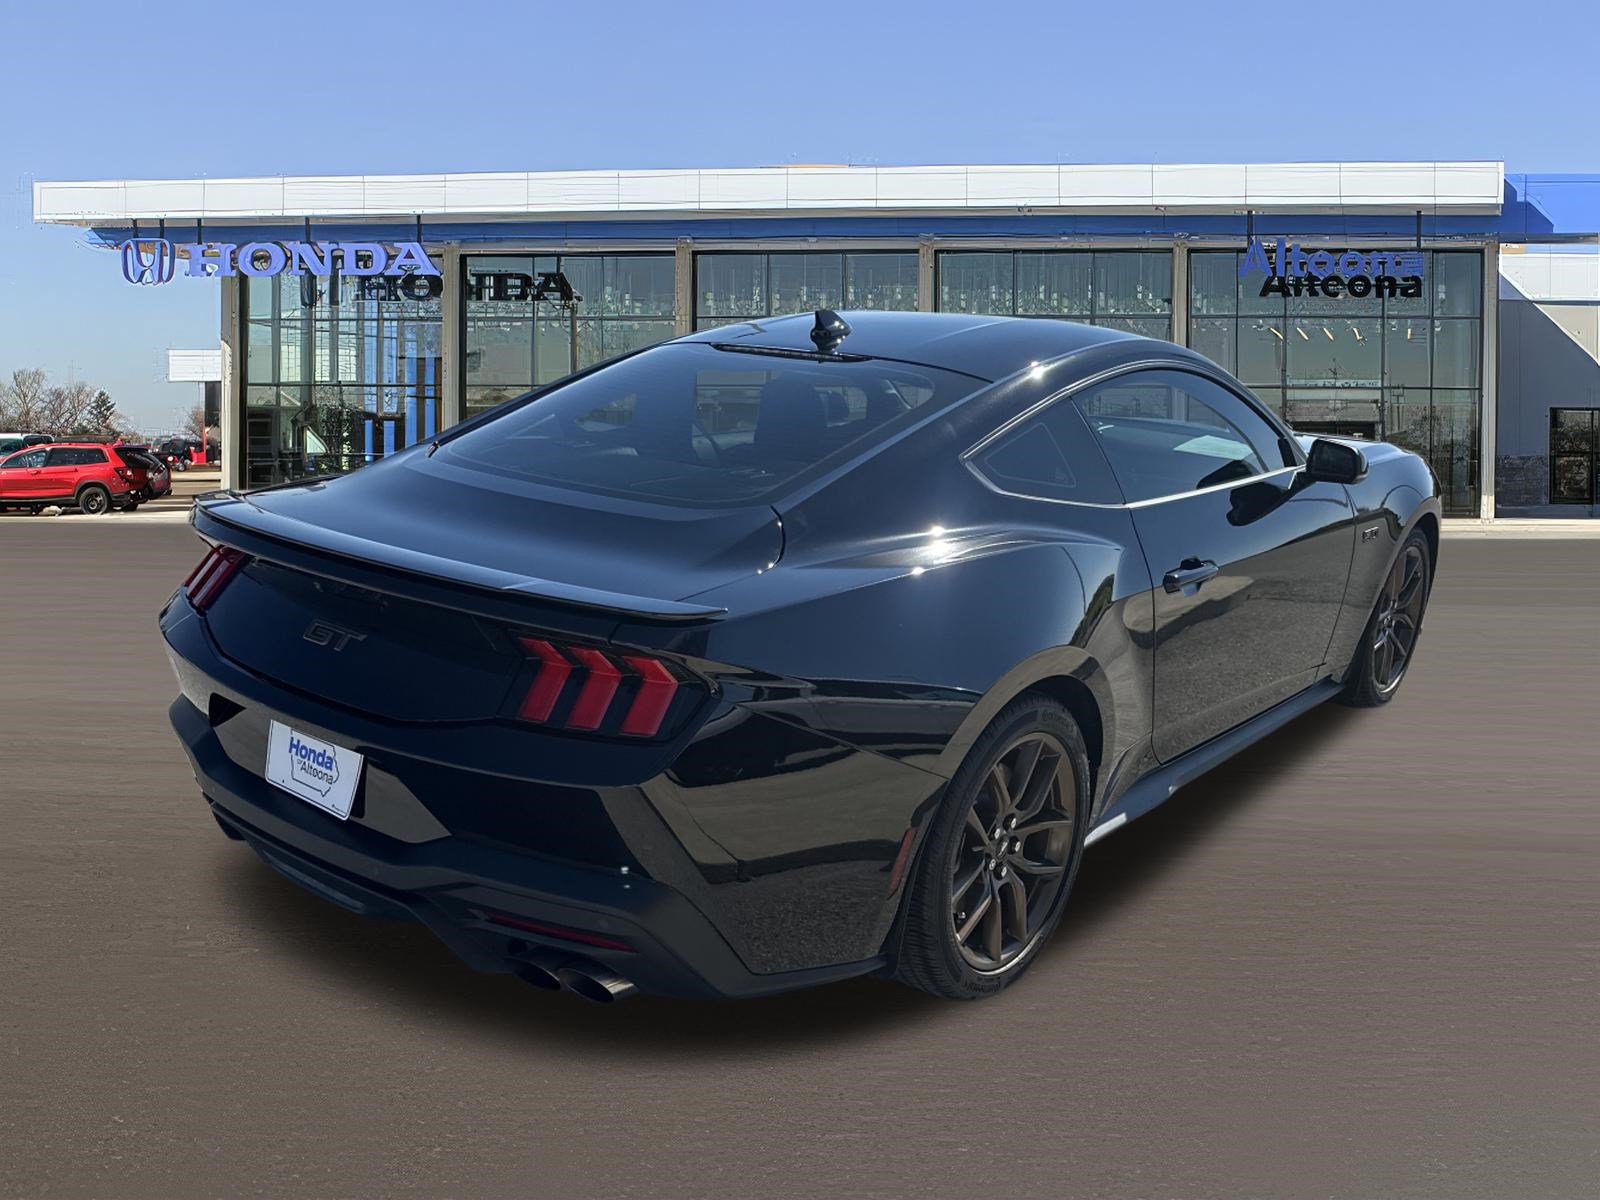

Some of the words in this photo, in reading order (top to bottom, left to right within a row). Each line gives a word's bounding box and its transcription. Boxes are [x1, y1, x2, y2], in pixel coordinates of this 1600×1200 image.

[184, 242, 442, 277] HONDA
[303, 619, 368, 651] GT
[289, 736, 333, 771] Honda
[300, 761, 334, 785] Altoona
